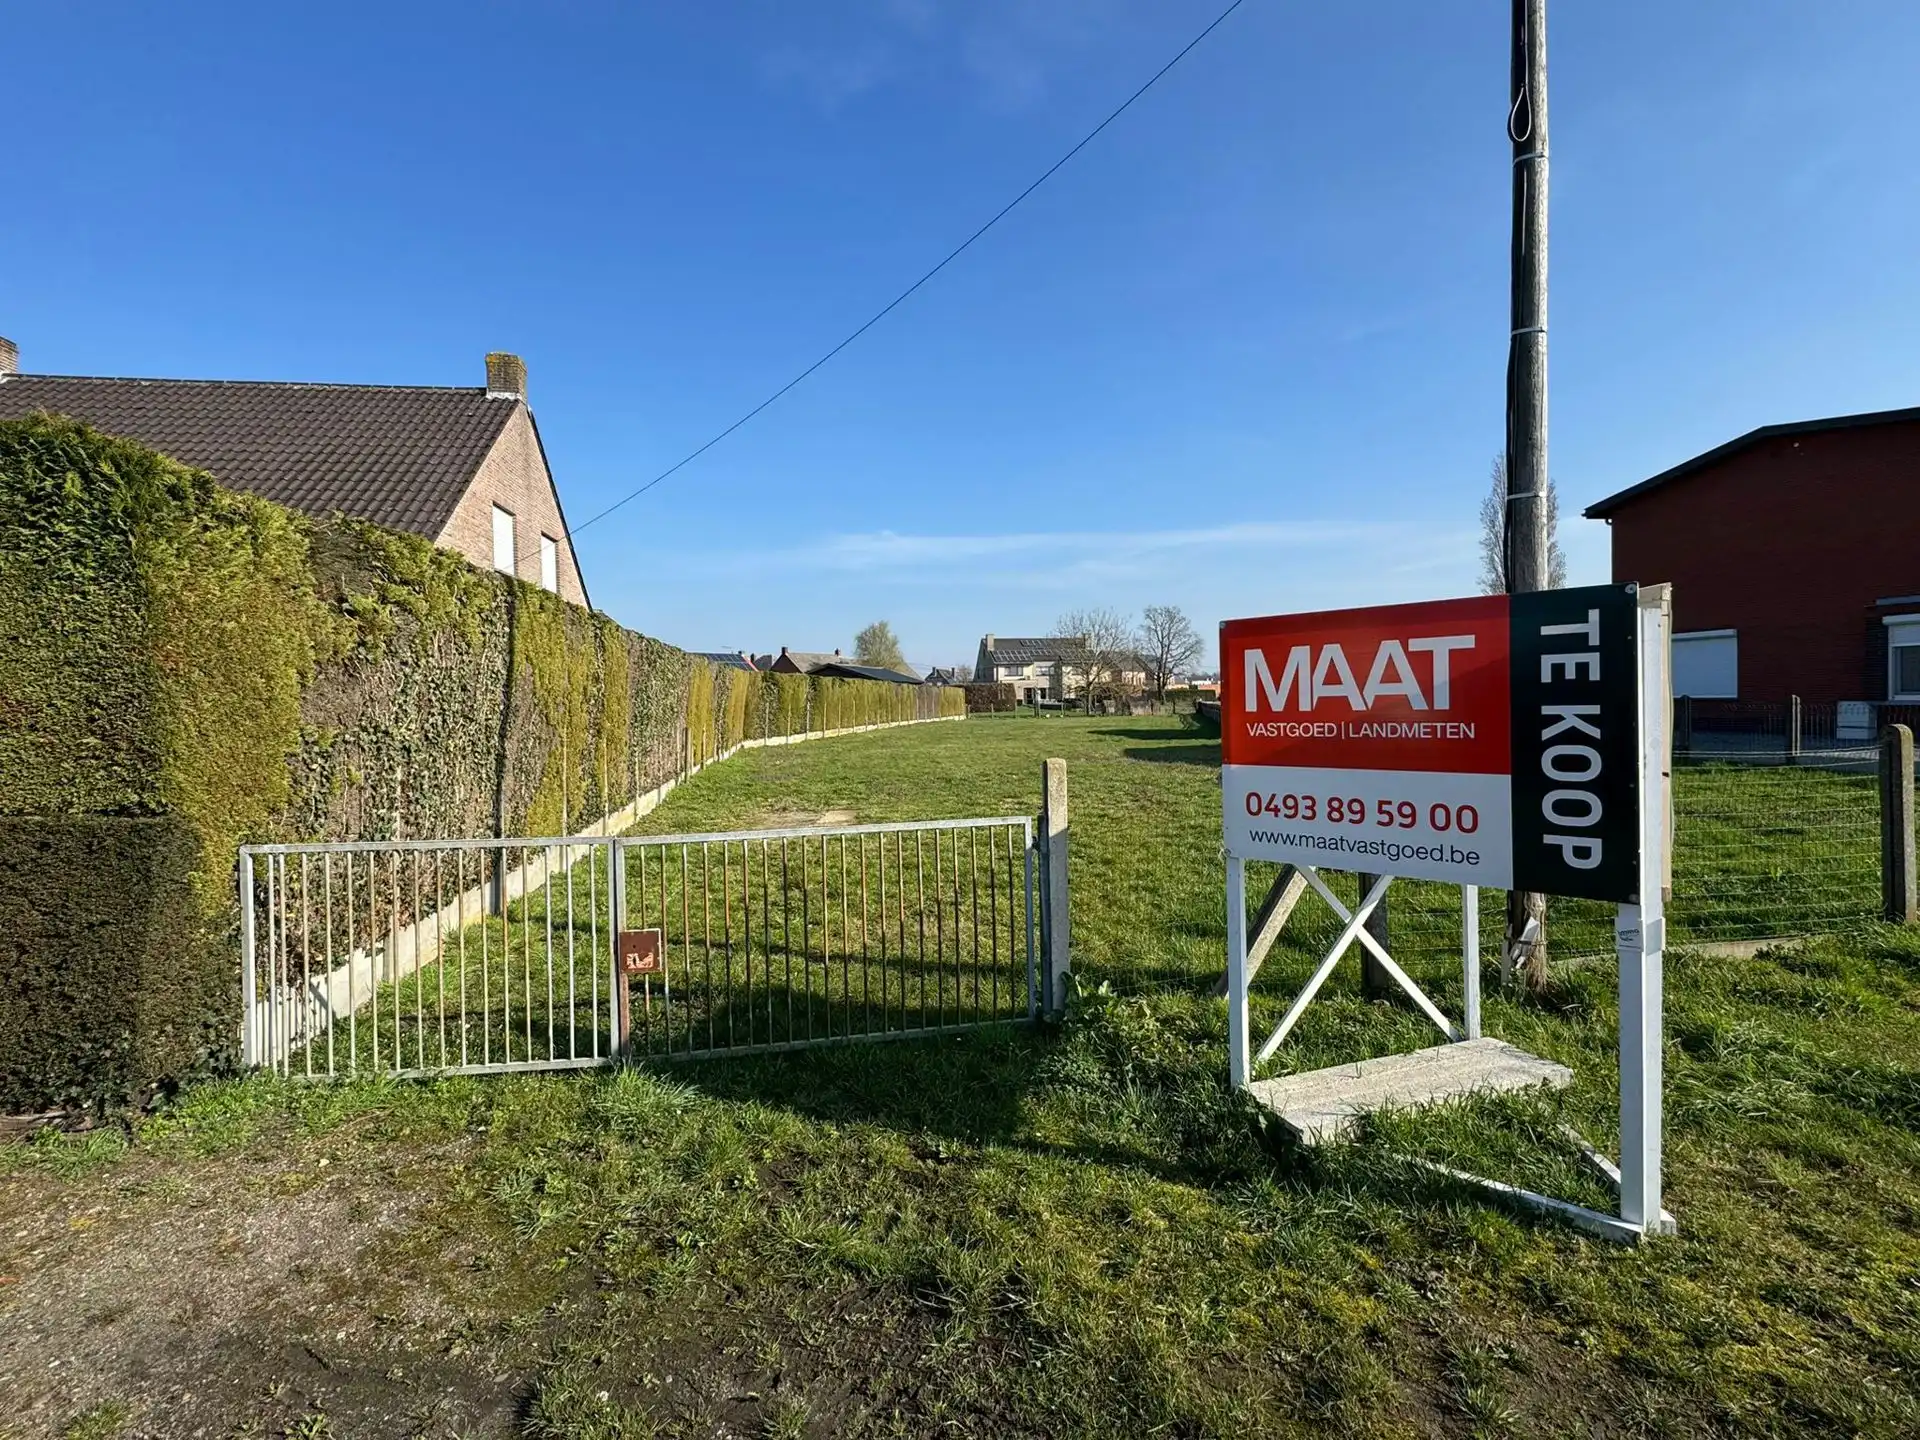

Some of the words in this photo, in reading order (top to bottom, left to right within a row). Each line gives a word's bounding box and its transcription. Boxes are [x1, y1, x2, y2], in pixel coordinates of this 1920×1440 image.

[1244, 634, 1476, 712] MAAT
[1540, 608, 1600, 684] TE
[1246, 722, 1337, 738] VASTGOED
[1349, 722, 1475, 739] LANDMETEN
[1245, 792, 1317, 821] 0493
[1327, 797, 1366, 825] 89
[1376, 800, 1417, 829] 59
[1429, 804, 1479, 834] 00
[1541, 704, 1603, 870] KOOP
[1249, 829, 1481, 866] www.maatvastgoed.be
